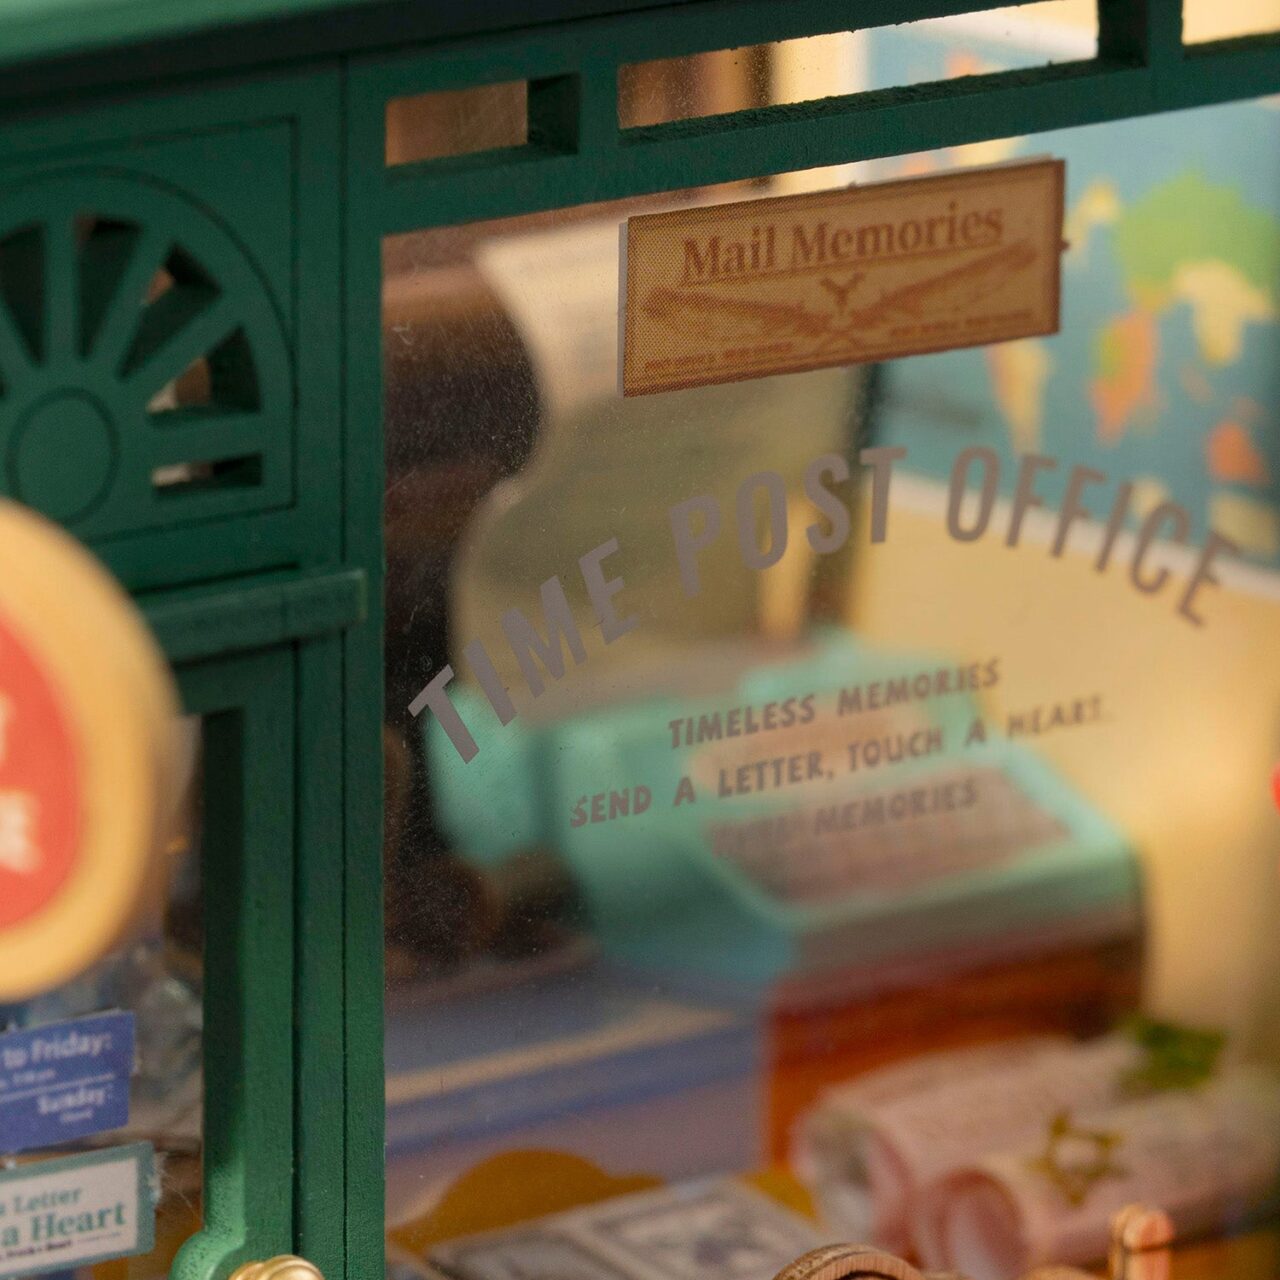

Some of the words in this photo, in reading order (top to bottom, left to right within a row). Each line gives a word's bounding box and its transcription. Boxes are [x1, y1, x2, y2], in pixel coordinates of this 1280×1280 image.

[683, 224, 776, 280] Mail
[794, 202, 1005, 266] Memories
[407, 537, 640, 765] TIME
[669, 446, 907, 599] POST
[946, 446, 1240, 629] OFFICE
[668, 695, 816, 750] TIMELESS
[837, 657, 1001, 717] MEMORIES
[570, 785, 653, 829] SEND
[673, 777, 696, 807] A
[717, 751, 835, 799] LETTER,
[847, 727, 943, 772] TOUCH
[964, 717, 987, 747] A
[814, 776, 978, 835] MEMORIES
[13, 1188, 82, 1214] Letter
[31, 1201, 126, 1241] Heart
